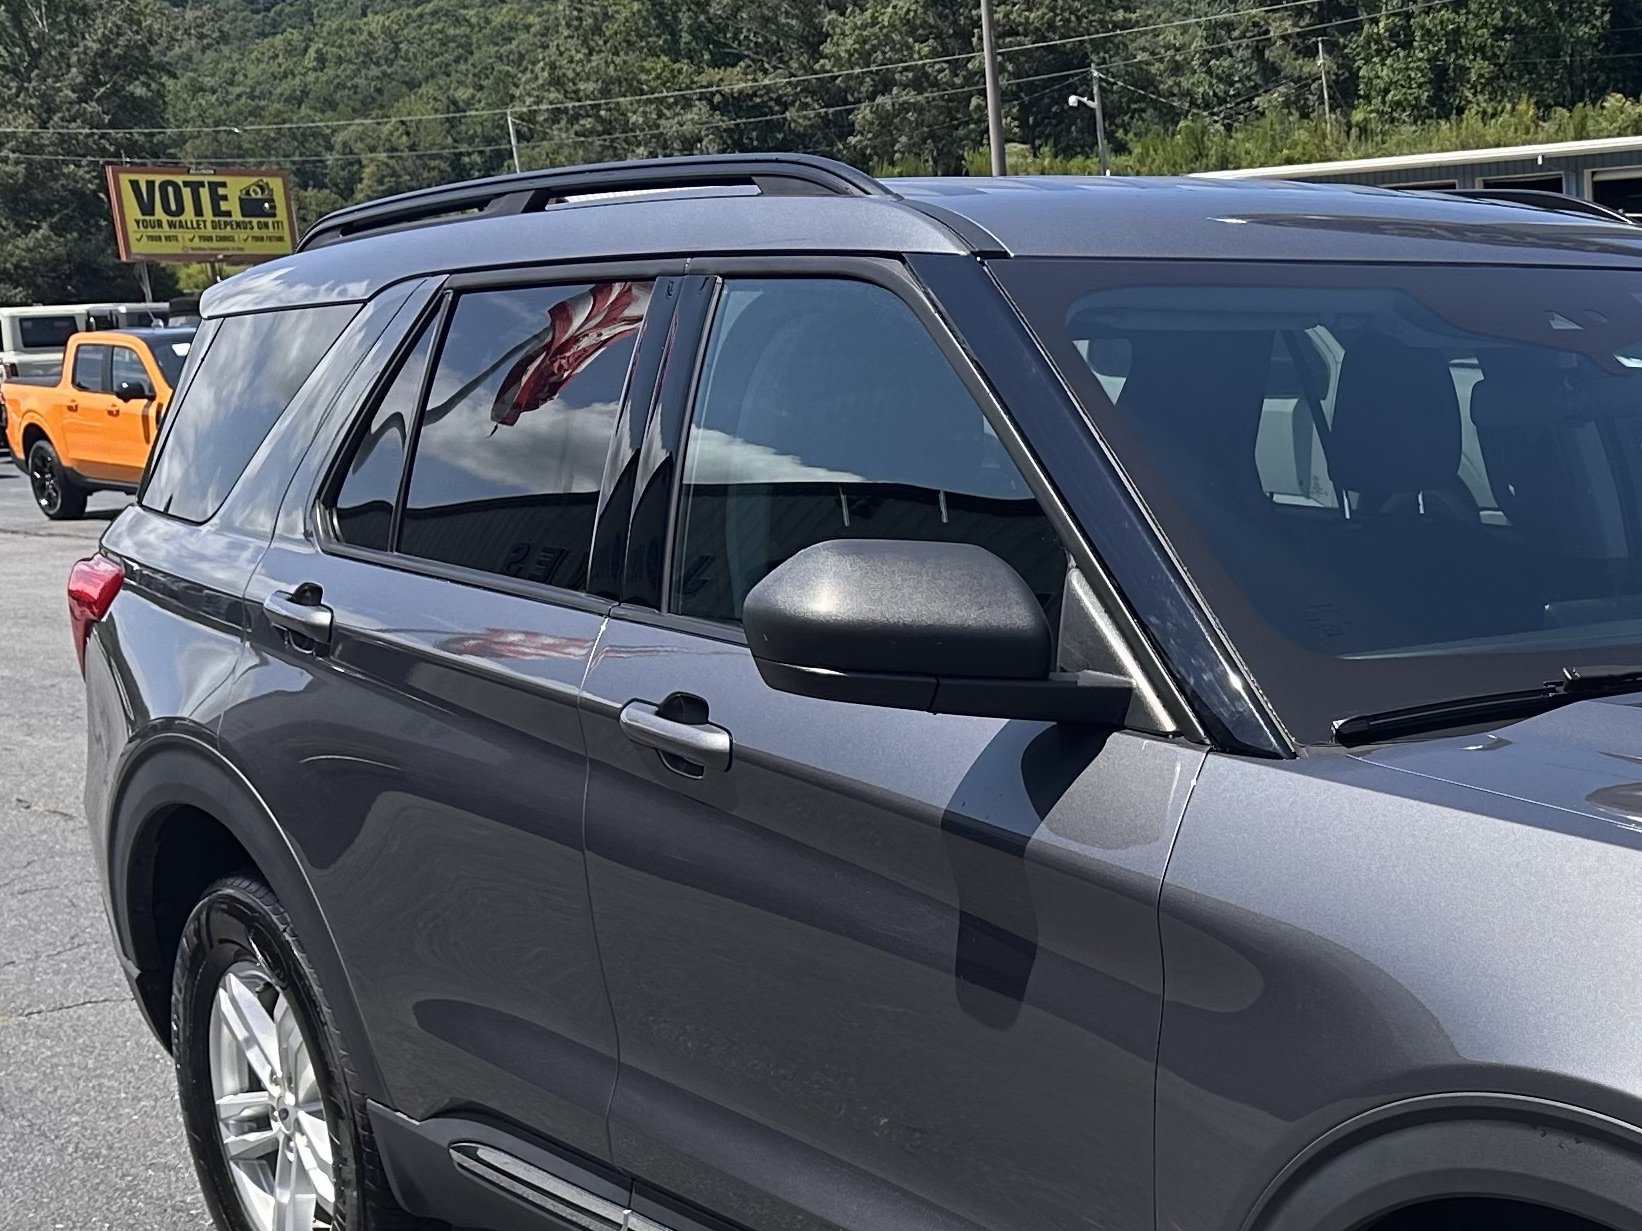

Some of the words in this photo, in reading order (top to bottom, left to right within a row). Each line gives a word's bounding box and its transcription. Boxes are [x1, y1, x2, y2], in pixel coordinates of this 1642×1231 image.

[128, 179, 233, 218] VOTE
[134, 218, 163, 229] YOUR
[167, 219, 207, 230] WALLET
[211, 219, 254, 231] DEPENDS
[256, 220, 269, 230] ON
[271, 220, 285, 231] IT!
